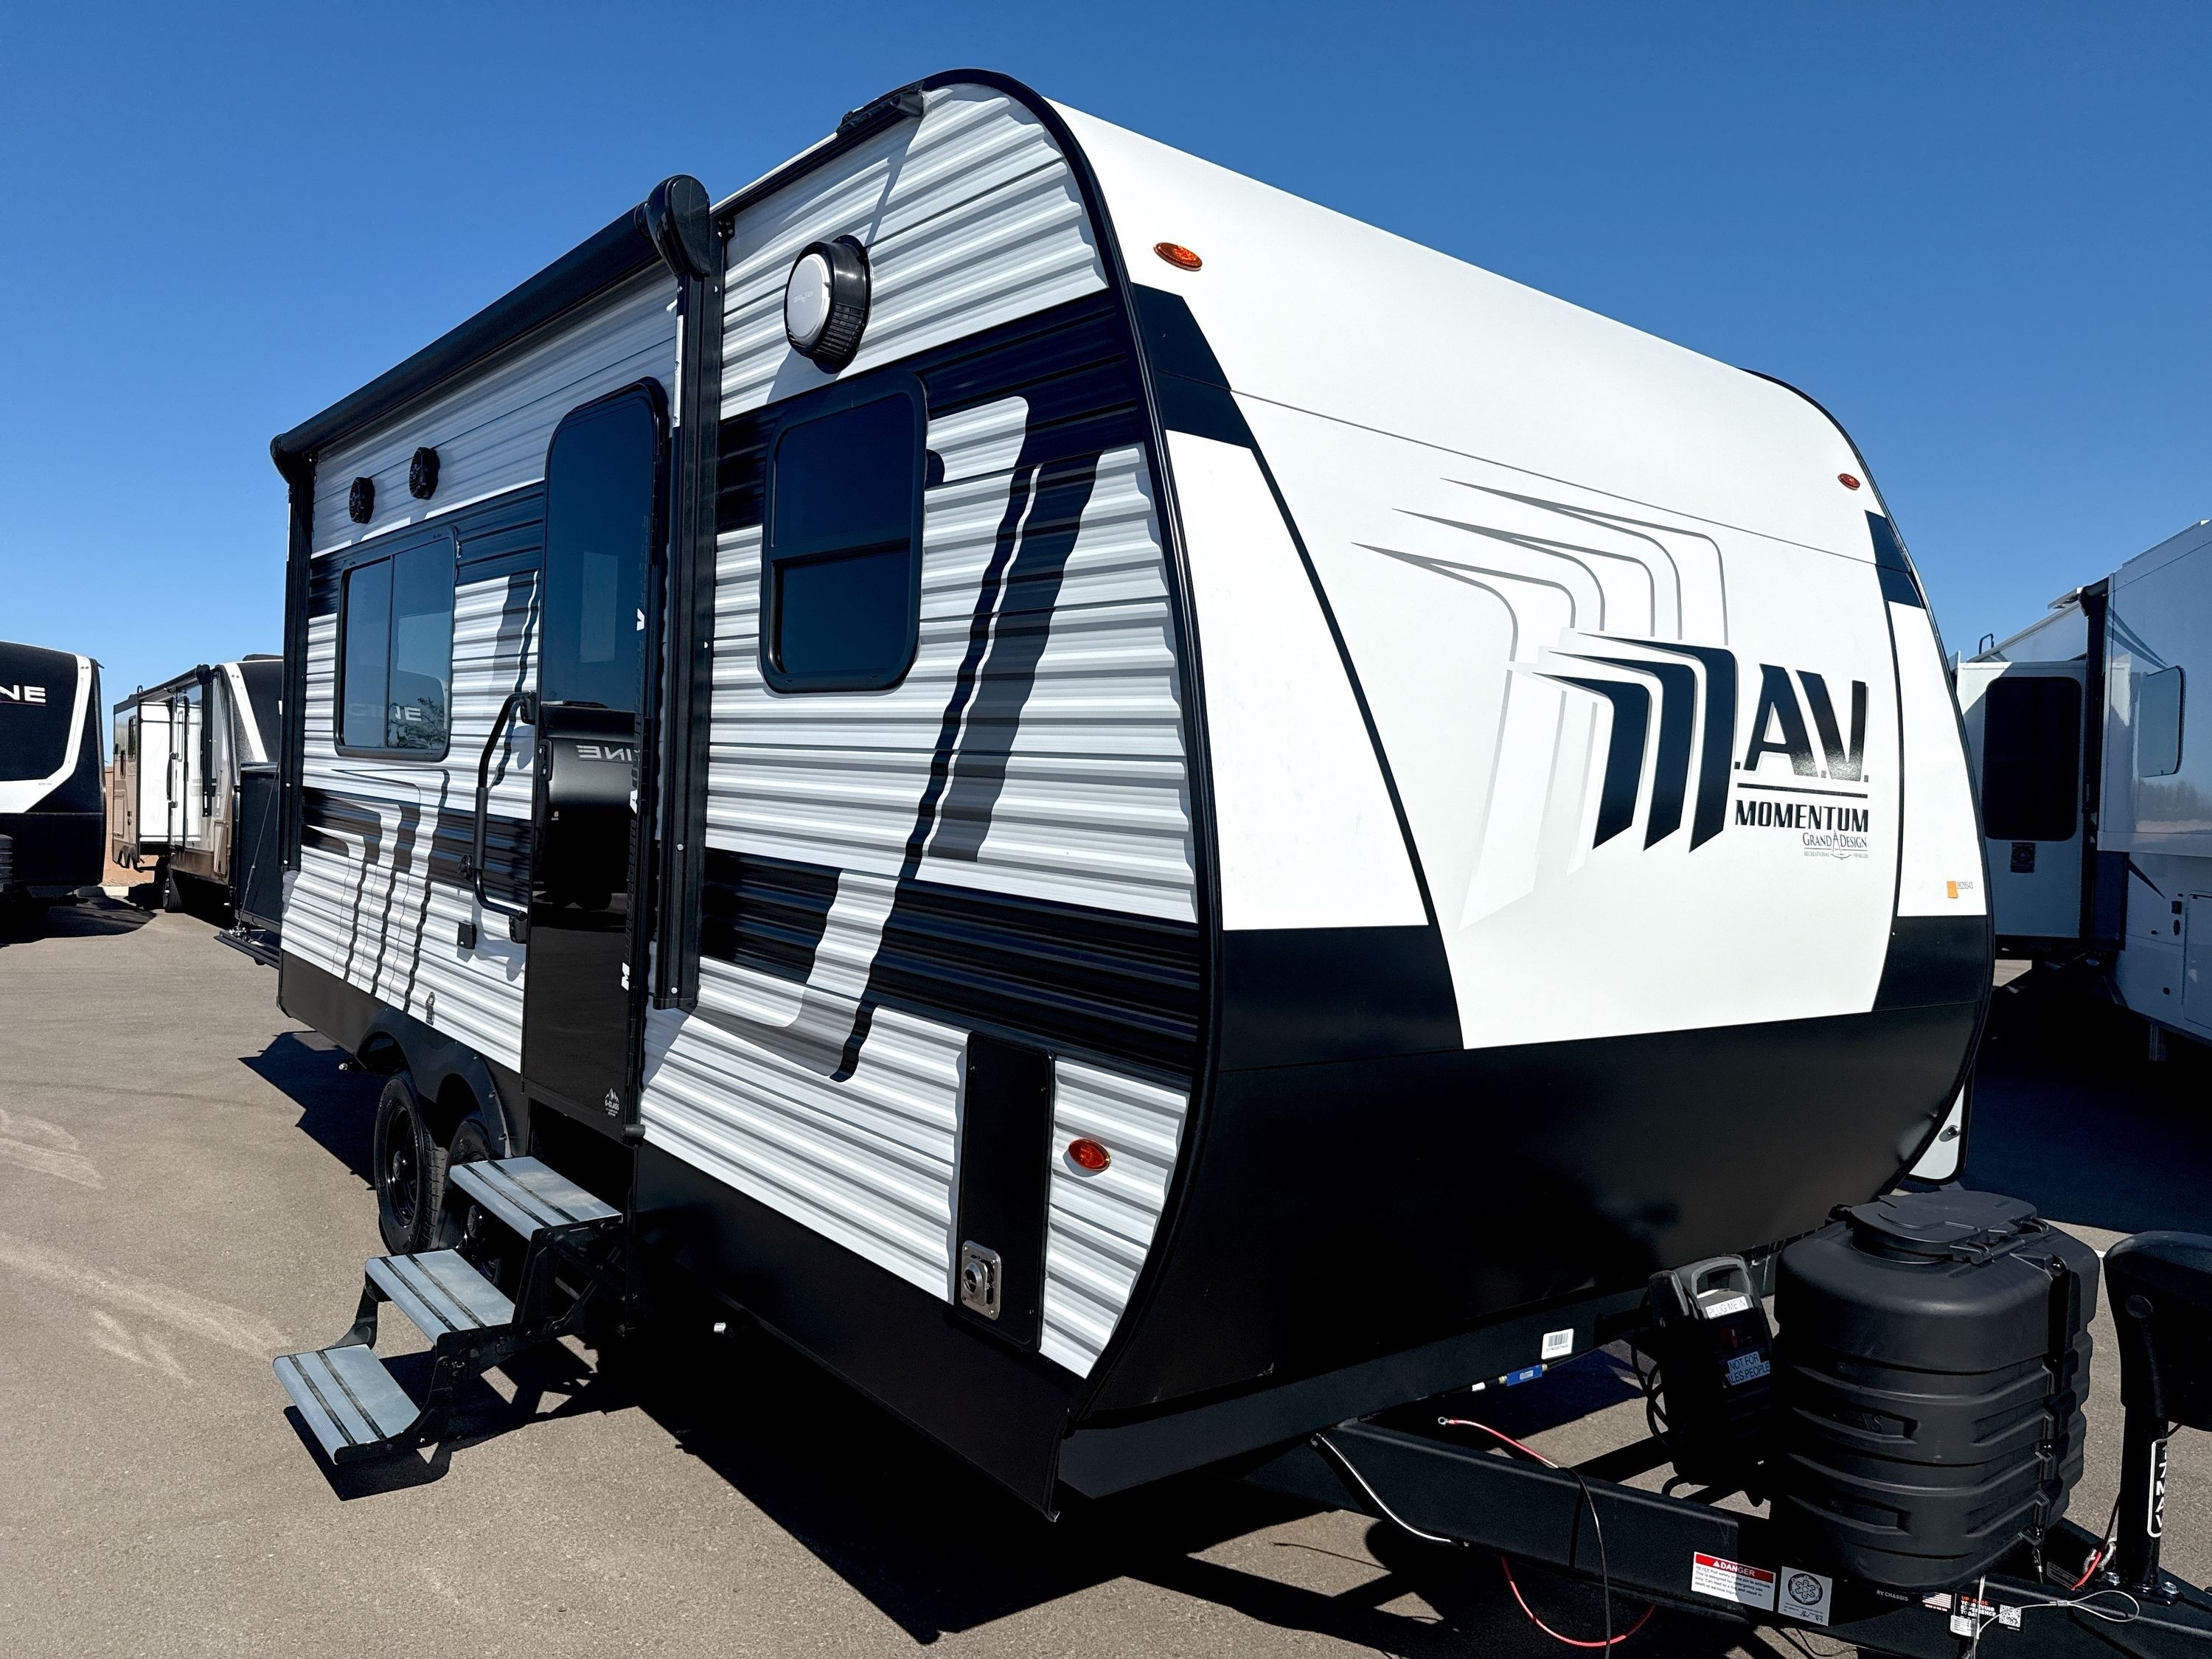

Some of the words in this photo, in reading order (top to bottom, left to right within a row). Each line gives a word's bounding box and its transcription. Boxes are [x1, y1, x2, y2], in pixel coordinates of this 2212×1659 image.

[1735, 799, 1868, 832] MOMENTUM
[1707, 1305, 1727, 1316] PLUG
[1728, 1301, 1739, 1311] ME
[1739, 1299, 1746, 1307] IN
[1729, 1358, 1744, 1371] NOT
[1745, 1353, 1759, 1366] FOR
[1745, 1362, 1770, 1378] PEOPLE
[1720, 1562, 1756, 1577] DANGER
[1961, 1595, 1989, 1605] UPRDE
